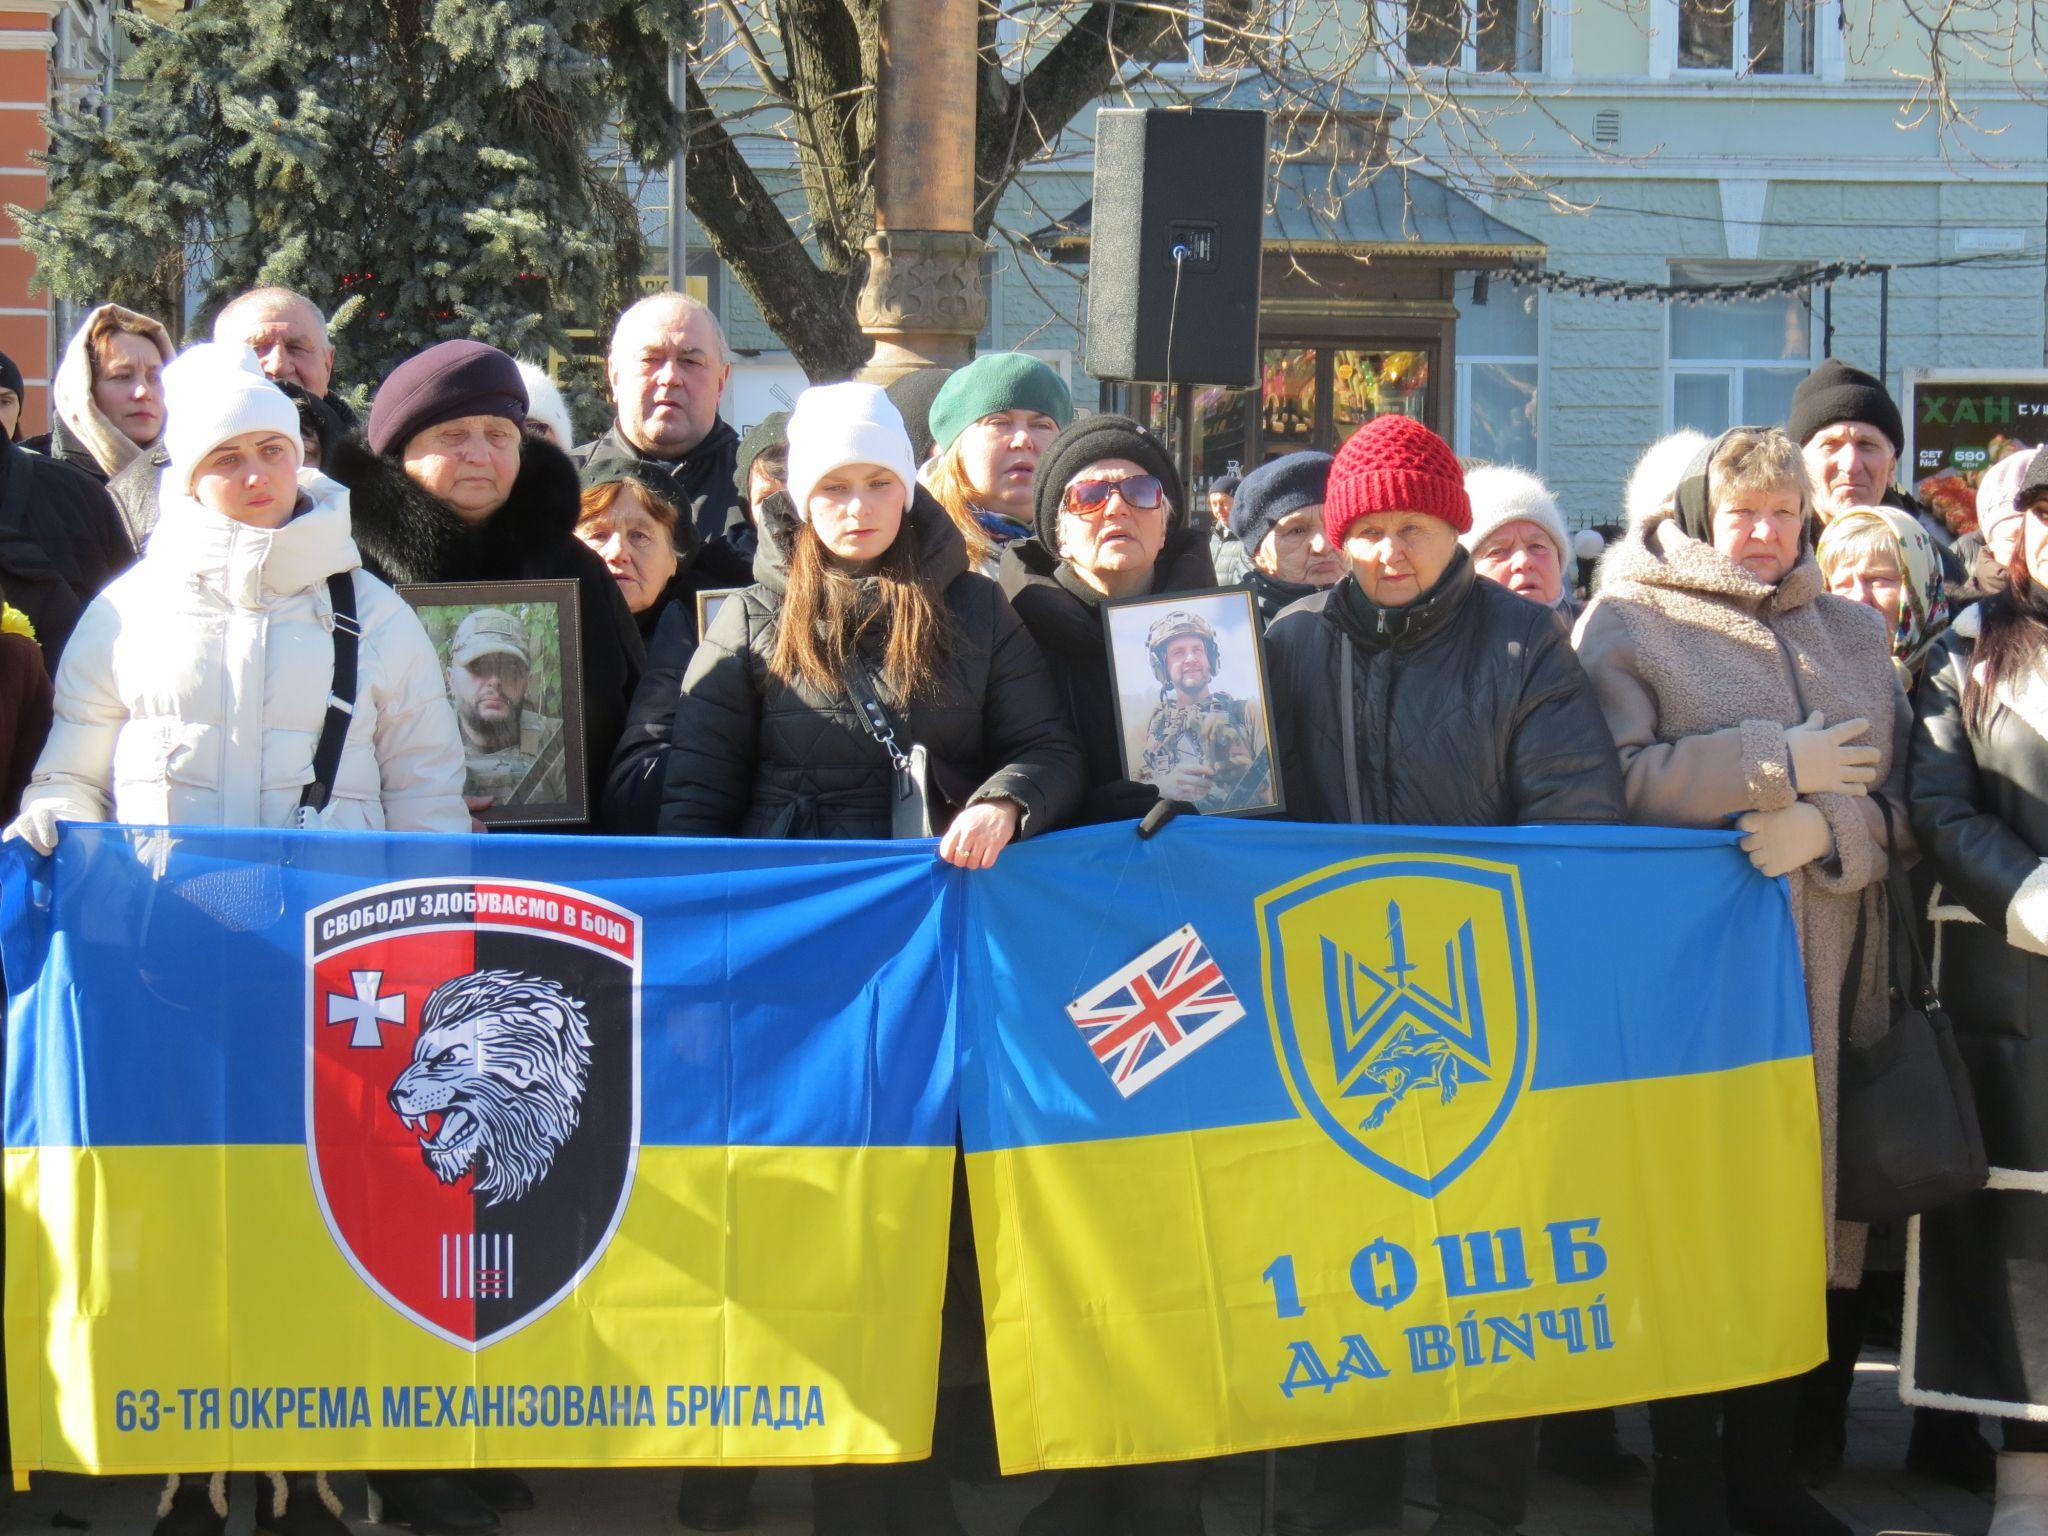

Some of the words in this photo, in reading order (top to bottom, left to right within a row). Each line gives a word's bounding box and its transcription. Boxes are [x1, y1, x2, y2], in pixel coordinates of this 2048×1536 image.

[1921, 395, 2010, 424] ХАН
[1919, 450, 1943, 459] СЕТ
[1954, 451, 1986, 461] 590
[323, 897, 416, 941] СВОБОДУ
[421, 892, 558, 923] ЗДОБУВАЄМО
[563, 908, 577, 927] В
[581, 912, 627, 944] БОЮ
[1278, 1333, 1392, 1399] ДА
[115, 1388, 220, 1432] 63-ТЯ
[229, 1386, 372, 1429] ОКРЕМА
[382, 1385, 656, 1428] МЕХАНІЗОВАНА
[666, 1385, 825, 1431] БРИГАДА
